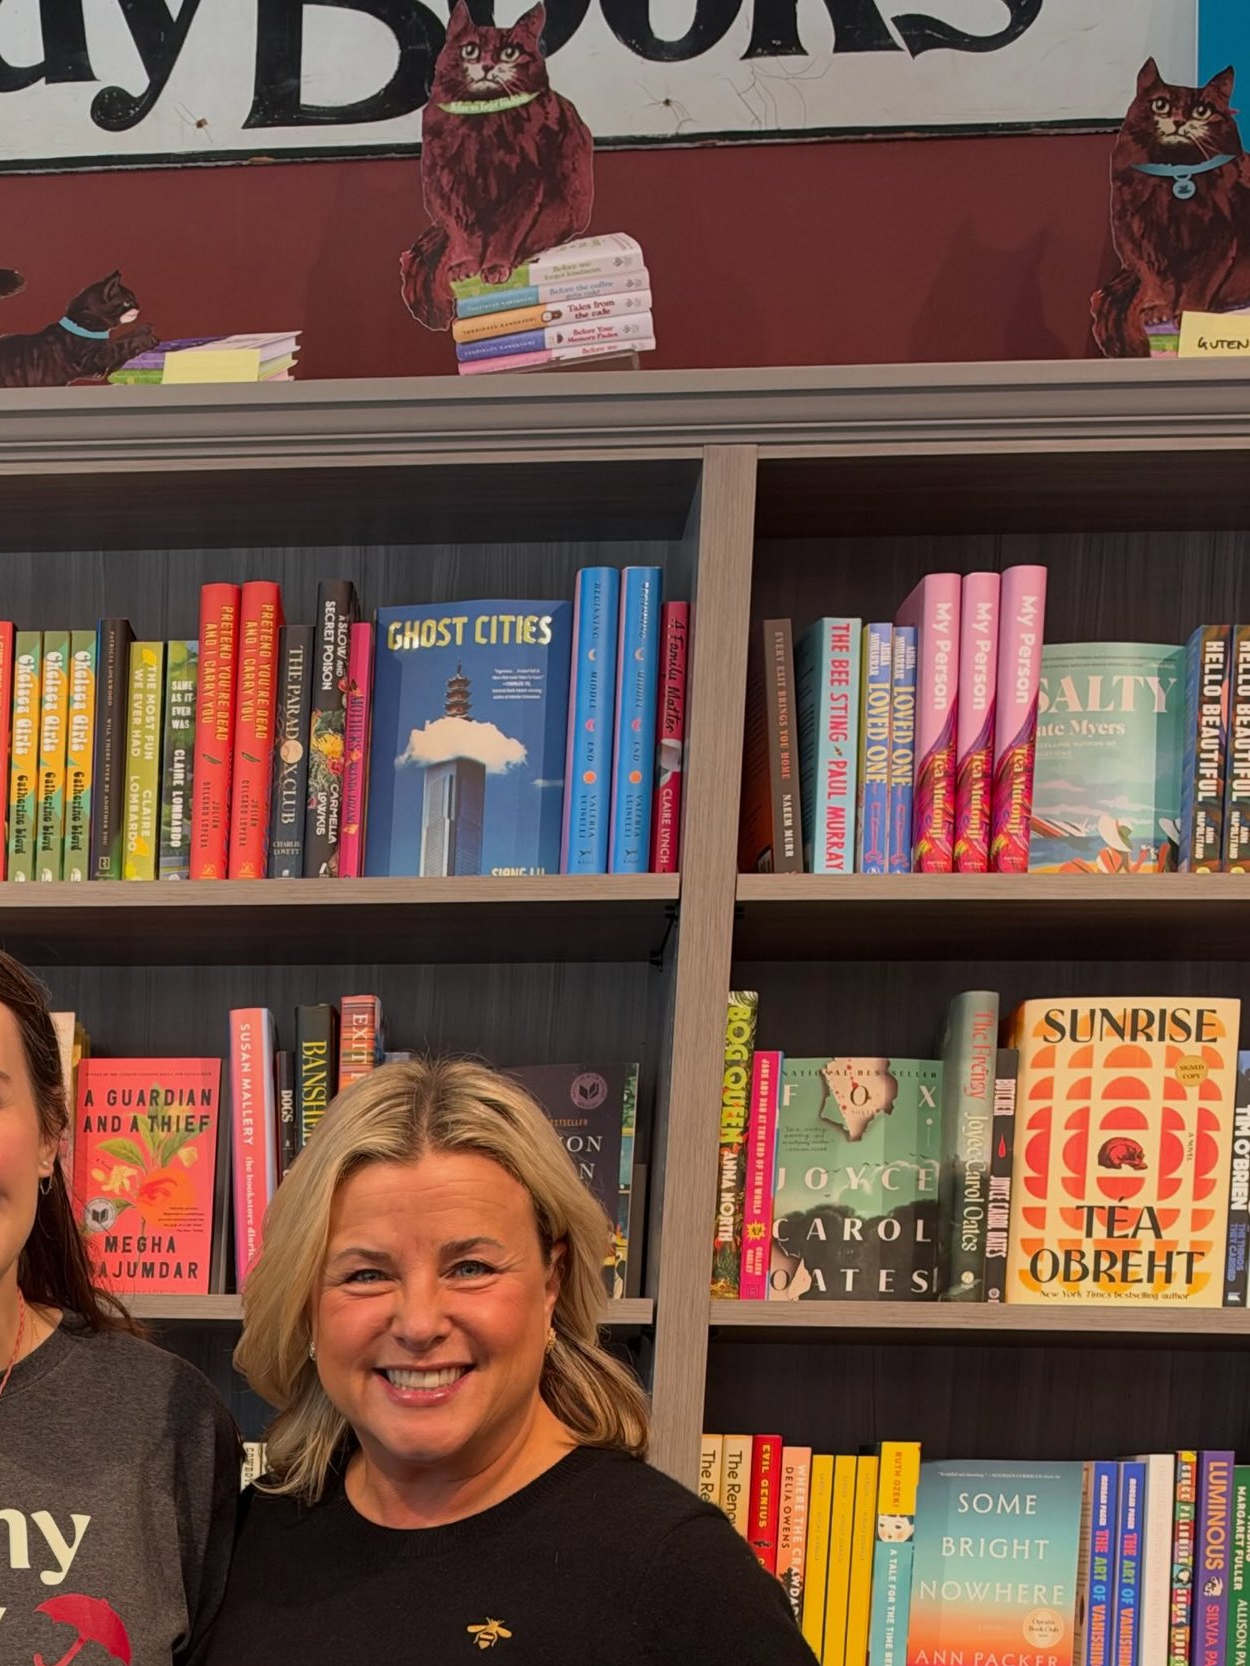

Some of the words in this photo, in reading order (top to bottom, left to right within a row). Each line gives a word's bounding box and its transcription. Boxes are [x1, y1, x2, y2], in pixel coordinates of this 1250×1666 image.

[567, 304, 591, 313] Tales
[594, 299, 615, 309] from
[575, 311, 590, 319] the
[387, 617, 463, 651] GHOST
[474, 615, 553, 646] CITIES
[830, 623, 849, 652] THE
[830, 658, 849, 687] BEE
[830, 693, 849, 742] STING
[1070, 720, 1125, 740] Myers
[827, 759, 847, 797] PAUL
[824, 802, 847, 871] MURRAY
[1043, 1008, 1218, 1043] SUNRISE
[1178, 1063, 1204, 1075] SIGNED
[1182, 1072, 1202, 1080] COPY
[85, 1089, 95, 1108] A
[106, 1089, 212, 1108] GUARDIAN
[83, 1115, 121, 1134] AND
[128, 1115, 139, 1133] A
[147, 1115, 210, 1133] THIEF
[776, 1168, 935, 1191] JOYCE
[772, 1218, 931, 1242] CAROL
[1076, 1197, 1163, 1240] TÉA
[104, 1235, 177, 1254] MEGHA
[92, 1260, 198, 1279] AJUMDAR
[1030, 1249, 1204, 1285] OBREHT
[770, 1269, 928, 1293] OATES
[957, 1493, 1036, 1515] SOME
[1203, 1460, 1227, 1571] LUMINOUS
[942, 1537, 1050, 1560] BRIGHT
[918, 1581, 1064, 1606] NOWHERE
[1203, 1604, 1220, 1649] SILVIA
[915, 1651, 962, 1666] ANN
